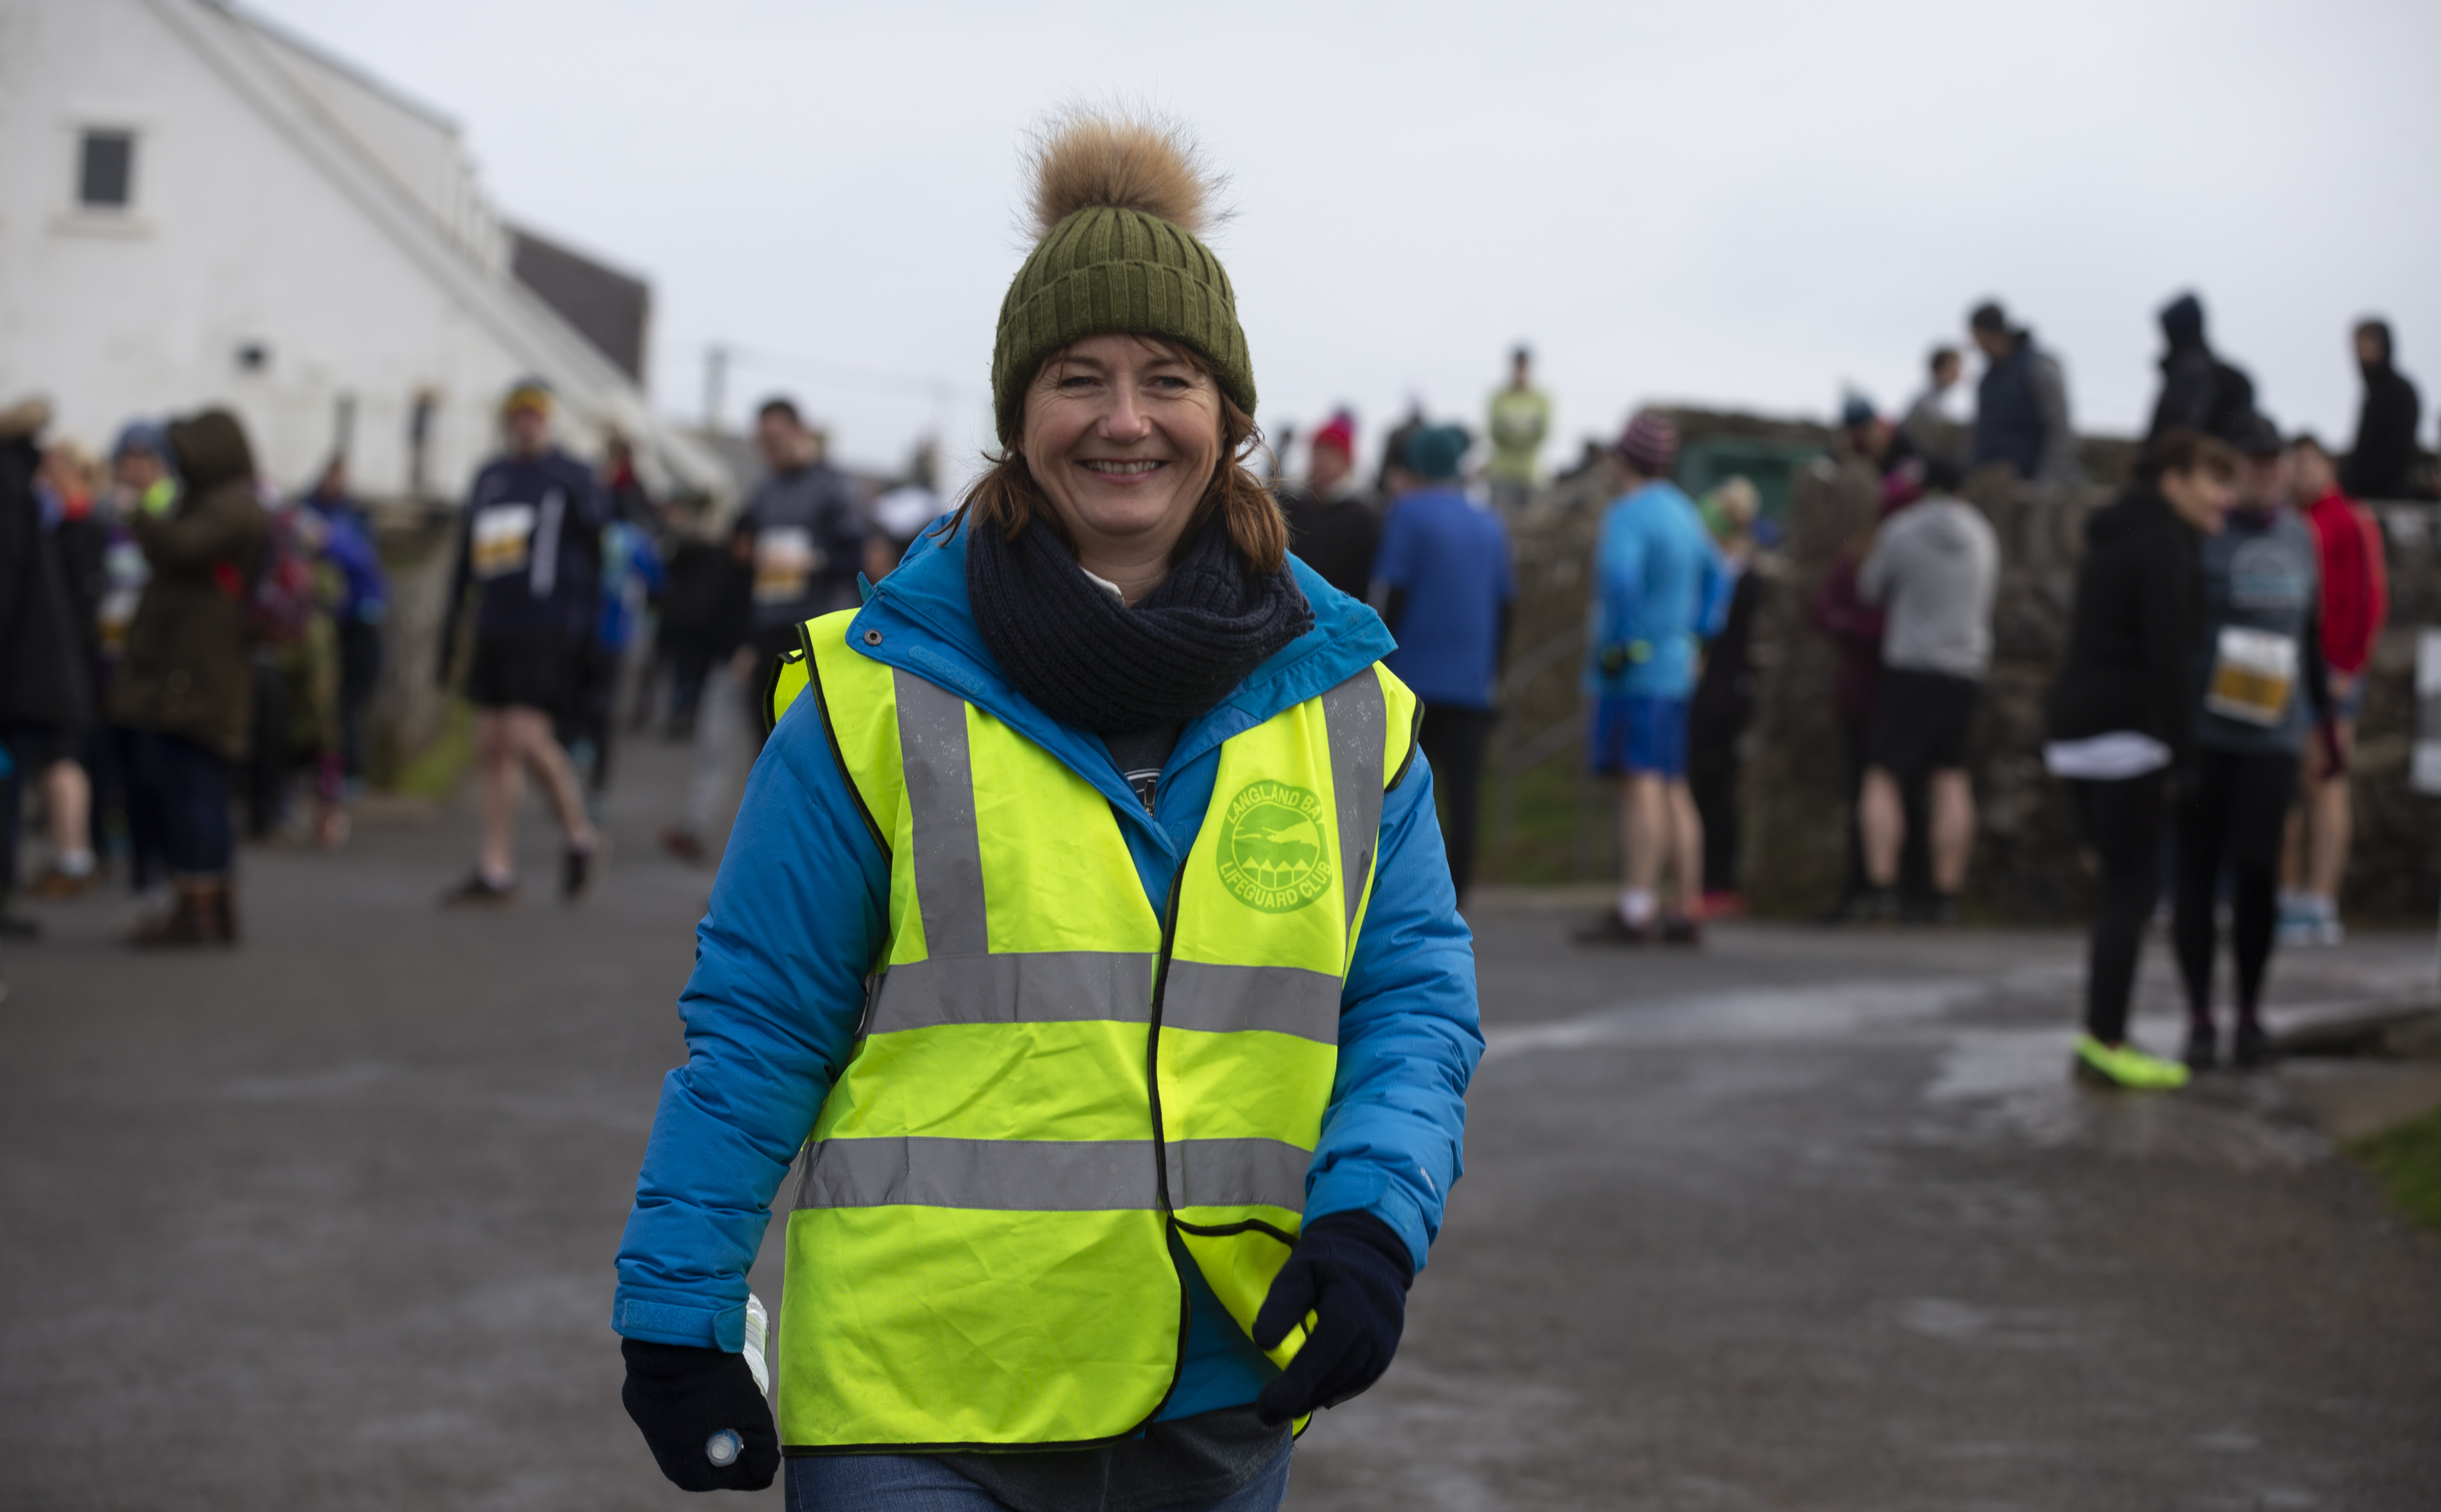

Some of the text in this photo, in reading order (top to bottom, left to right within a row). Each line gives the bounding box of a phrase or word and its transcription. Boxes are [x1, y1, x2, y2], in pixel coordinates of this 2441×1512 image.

[1227, 785, 1324, 824] LANGLAND BAY
[1220, 861, 1331, 907] LIFEGUARD CLUB
